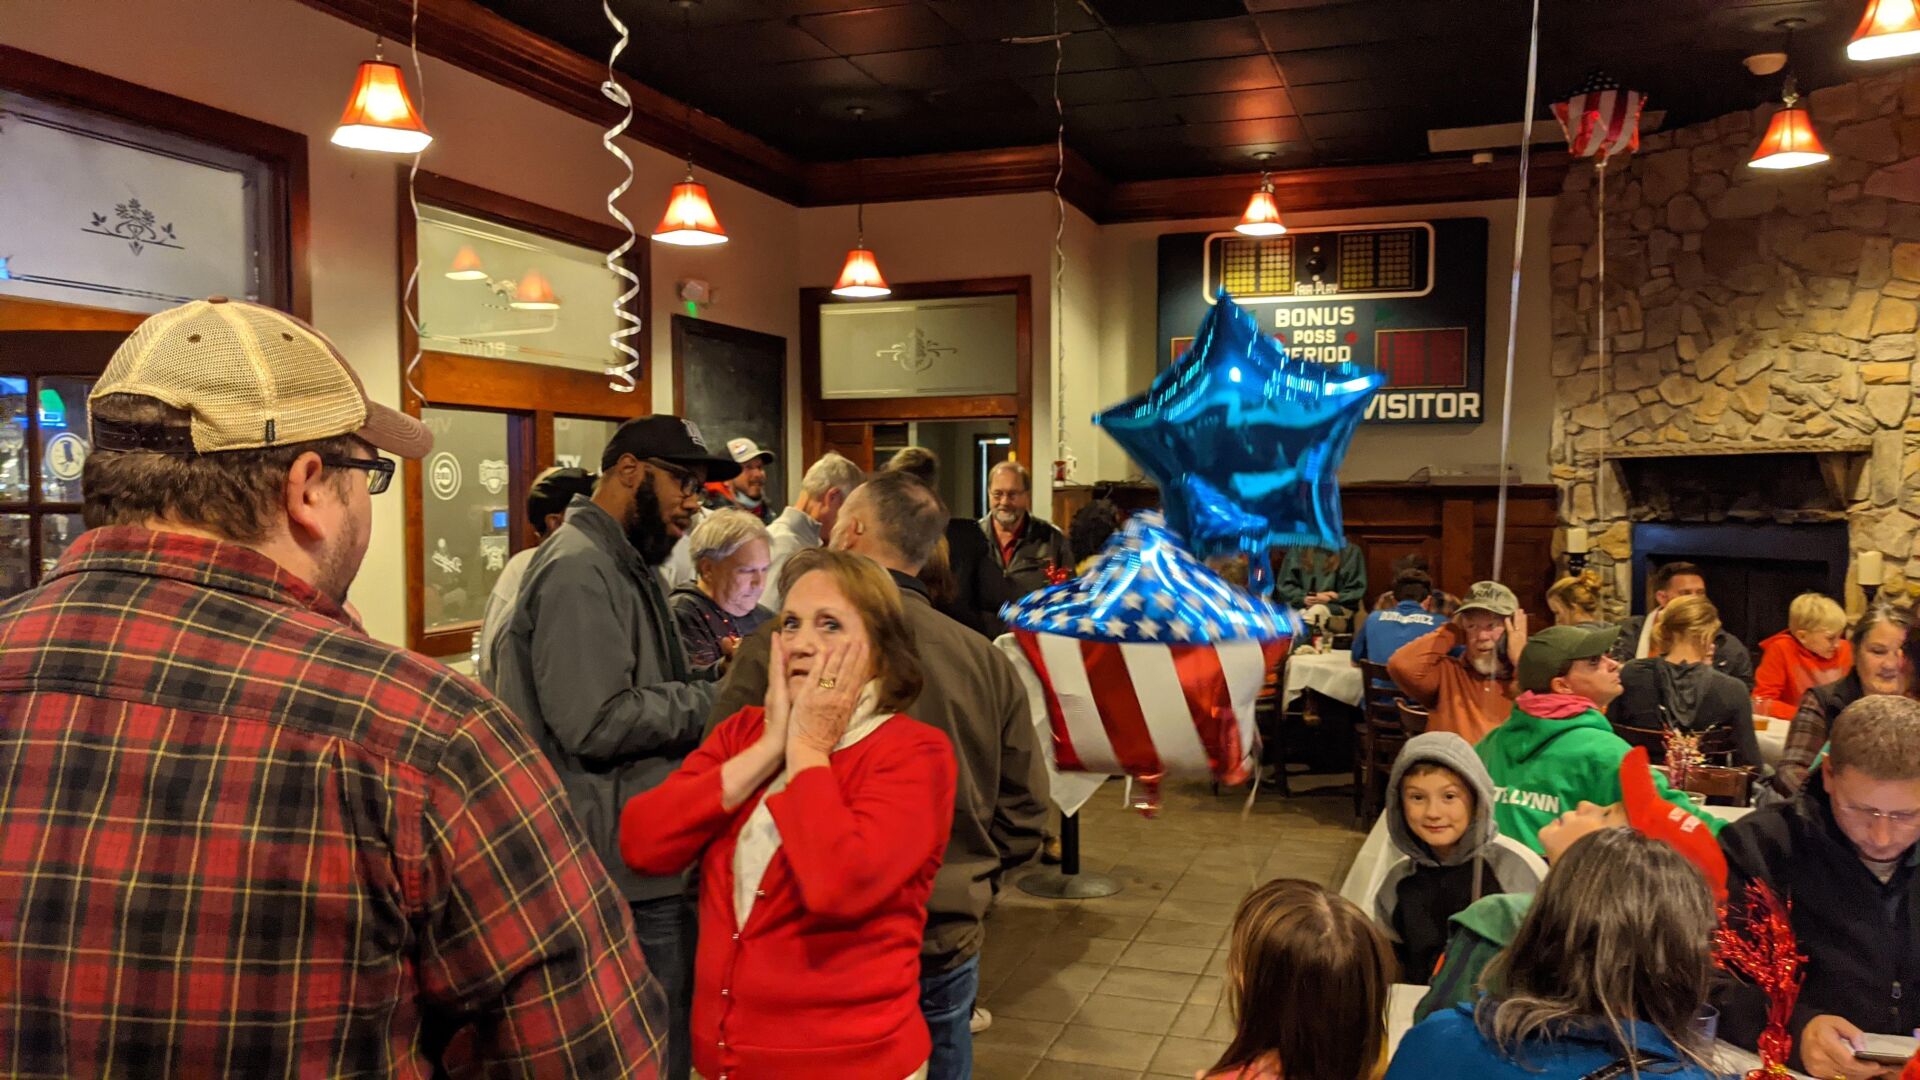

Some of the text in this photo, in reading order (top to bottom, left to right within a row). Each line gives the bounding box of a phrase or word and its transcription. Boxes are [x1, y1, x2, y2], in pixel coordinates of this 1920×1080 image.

[1275, 306, 1355, 328] BONUS
[1293, 329, 1336, 344] POSS
[1363, 391, 1480, 420] VISITOR
